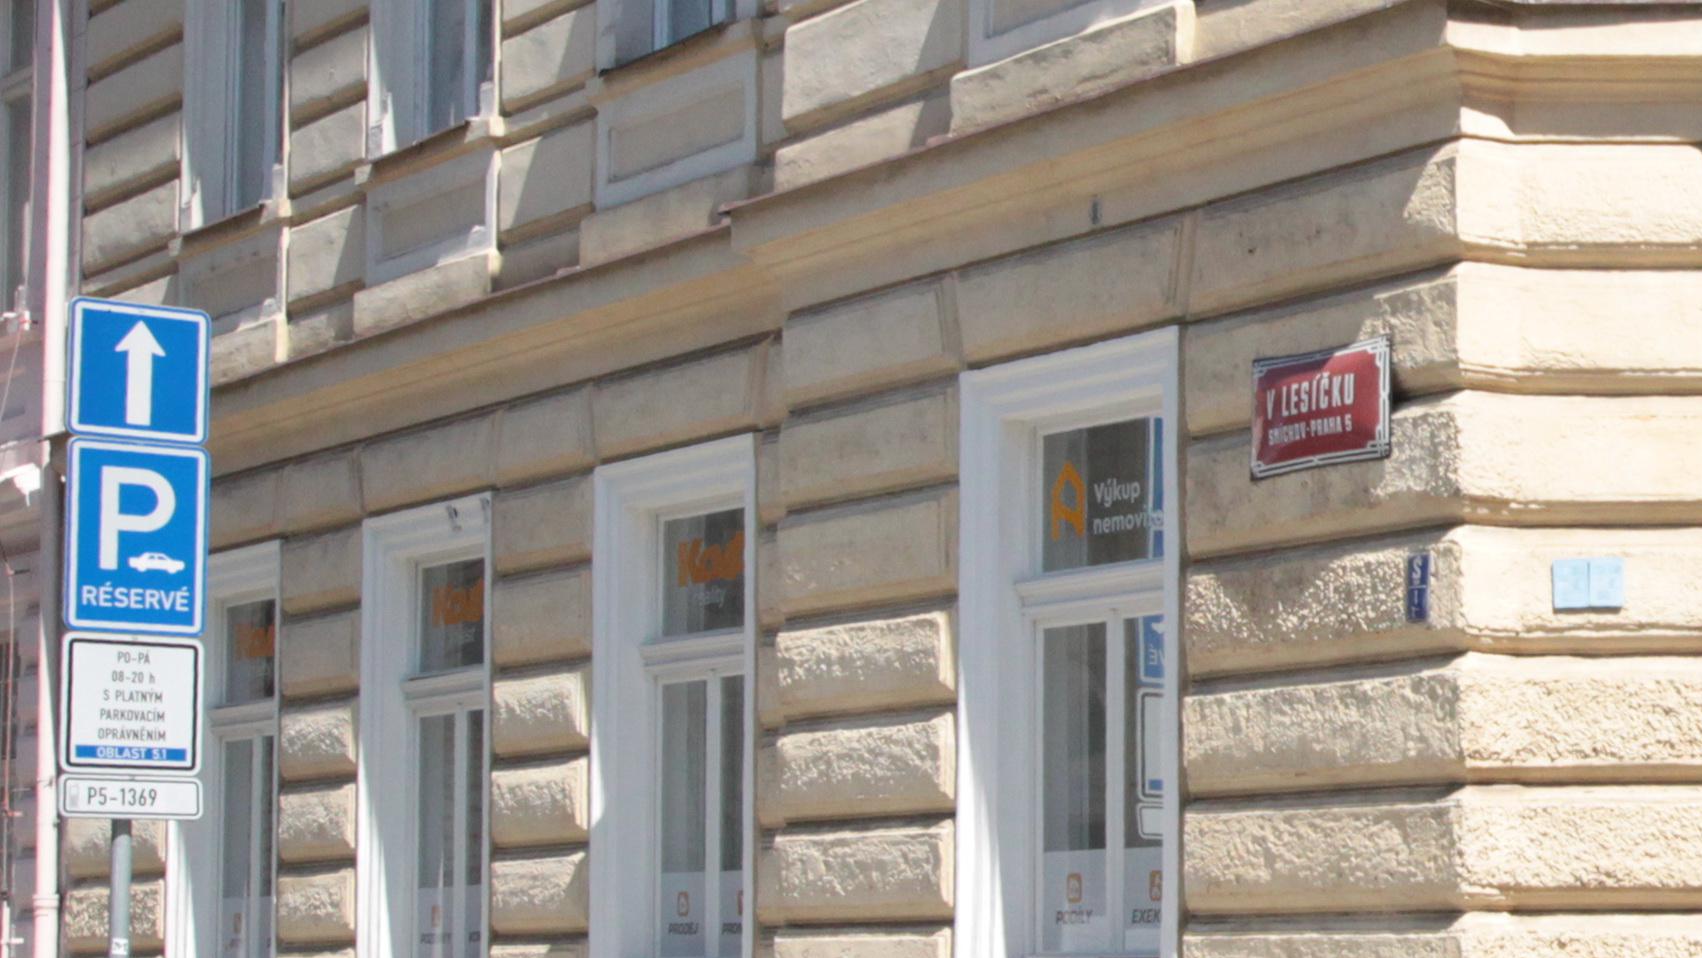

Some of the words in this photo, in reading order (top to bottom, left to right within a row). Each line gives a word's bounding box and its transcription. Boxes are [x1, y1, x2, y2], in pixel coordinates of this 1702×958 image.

[1266, 388, 1276, 421] V
[1281, 371, 1355, 418] LESÍČKU
[1344, 413, 1353, 432] 5
[1093, 477, 1141, 508] Výkup
[99, 465, 176, 571] P
[81, 581, 190, 612] RÉSERVÉ
[117, 650, 151, 665] PO-PÁ
[111, 669, 145, 683] 08-20
[148, 671, 156, 684] h
[103, 688, 110, 701] S
[115, 688, 163, 703] PLATNÝM
[99, 707, 165, 723] PARKOVACÍM
[97, 727, 167, 742] OPRÁVNĚNÍM
[96, 746, 146, 760] OBLAST
[87, 785, 158, 807] P5-1369
